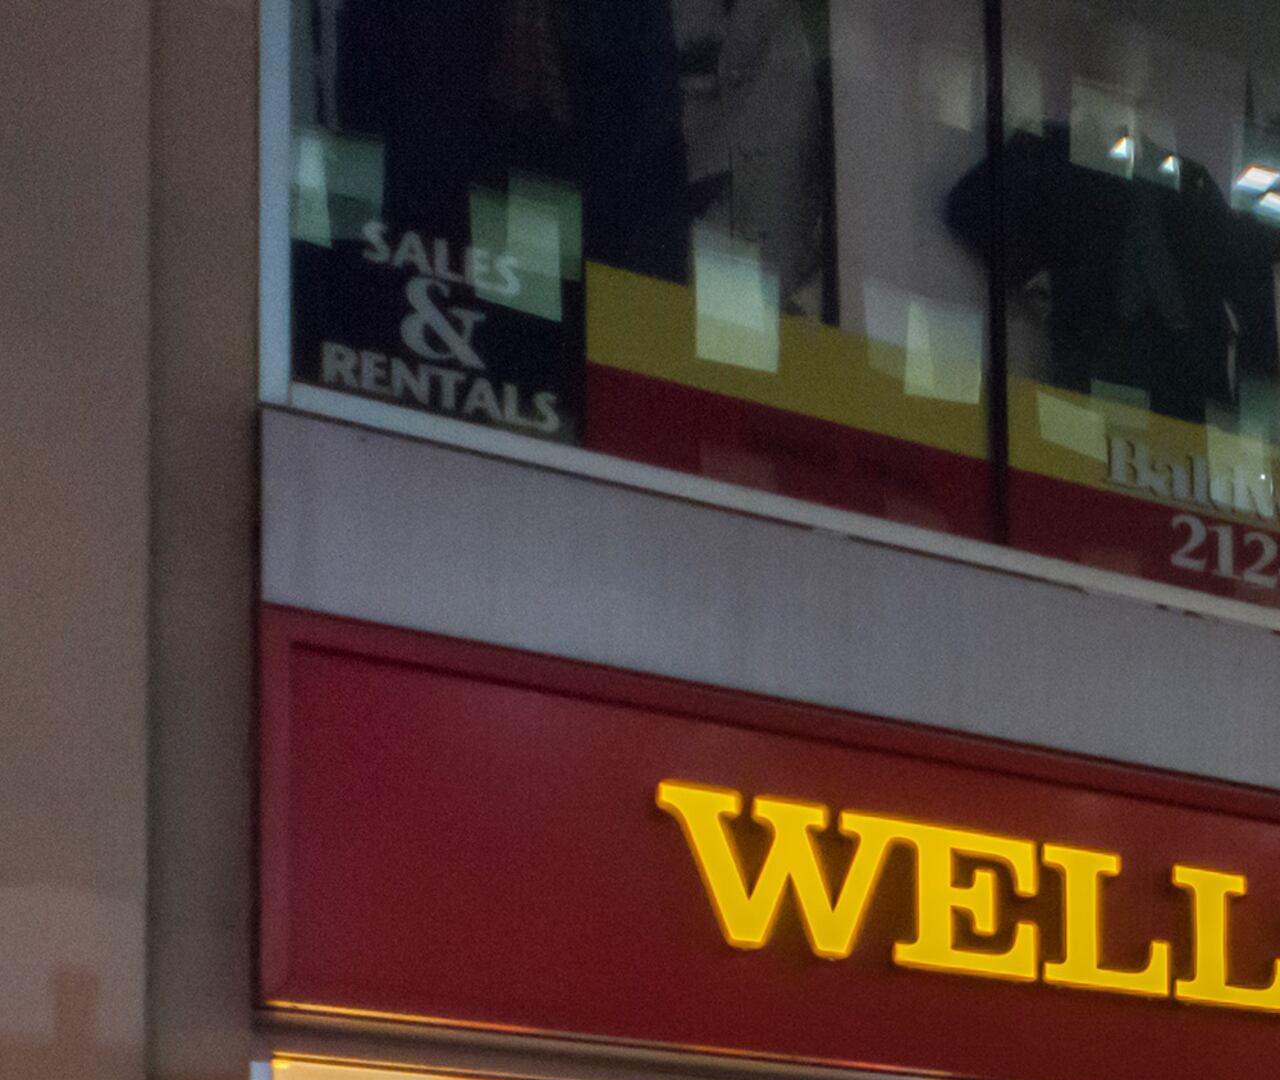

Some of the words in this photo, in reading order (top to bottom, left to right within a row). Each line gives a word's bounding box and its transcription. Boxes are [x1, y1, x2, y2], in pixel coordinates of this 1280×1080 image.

[362, 220, 521, 298] SALES
[400, 274, 486, 370] &
[321, 340, 561, 433] RENTALS
